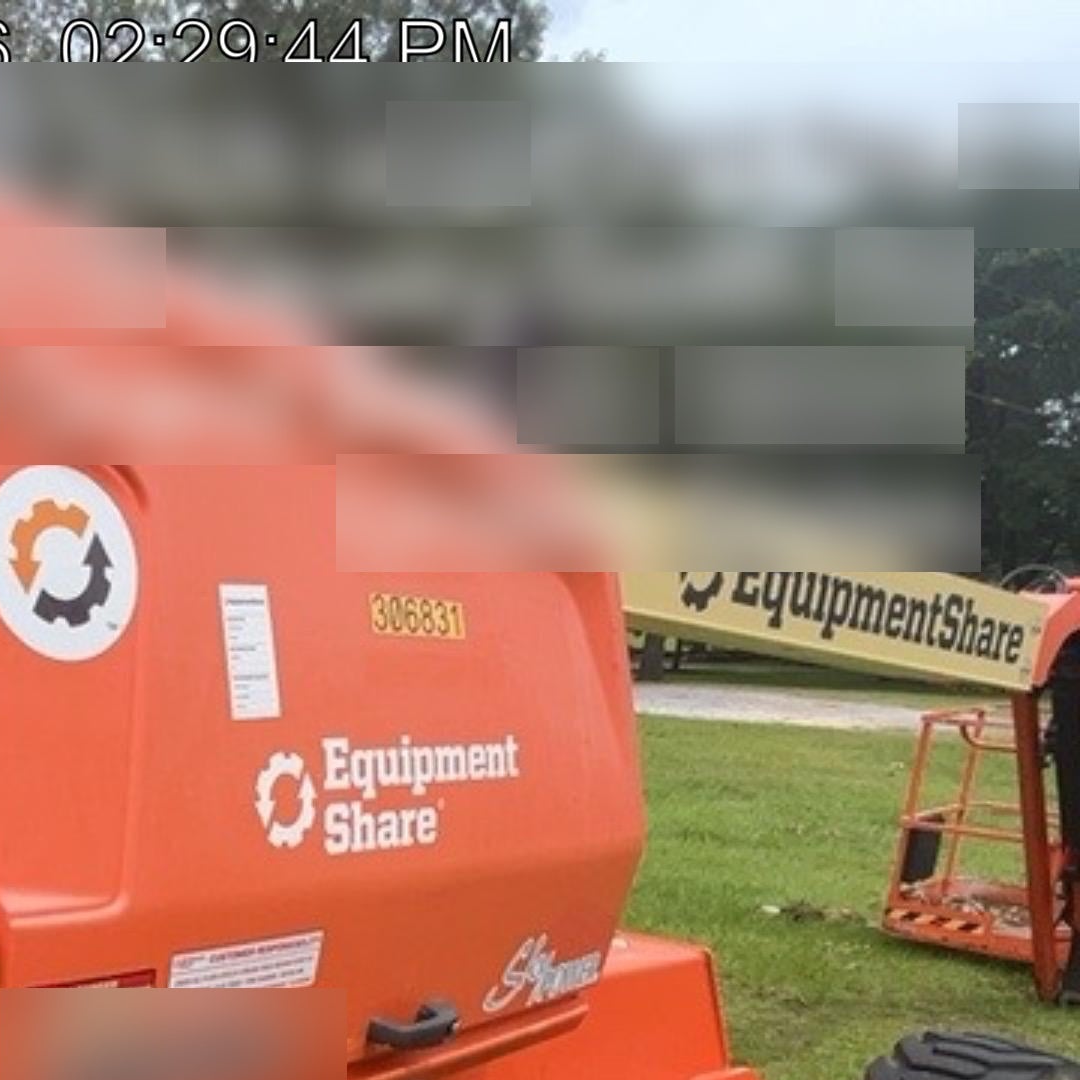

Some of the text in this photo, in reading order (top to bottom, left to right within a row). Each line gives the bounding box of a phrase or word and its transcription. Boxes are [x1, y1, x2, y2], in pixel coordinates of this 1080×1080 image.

[371, 593, 461, 636] 306831
[322, 735, 520, 799] Equipment
[324, 801, 438, 855] Share
